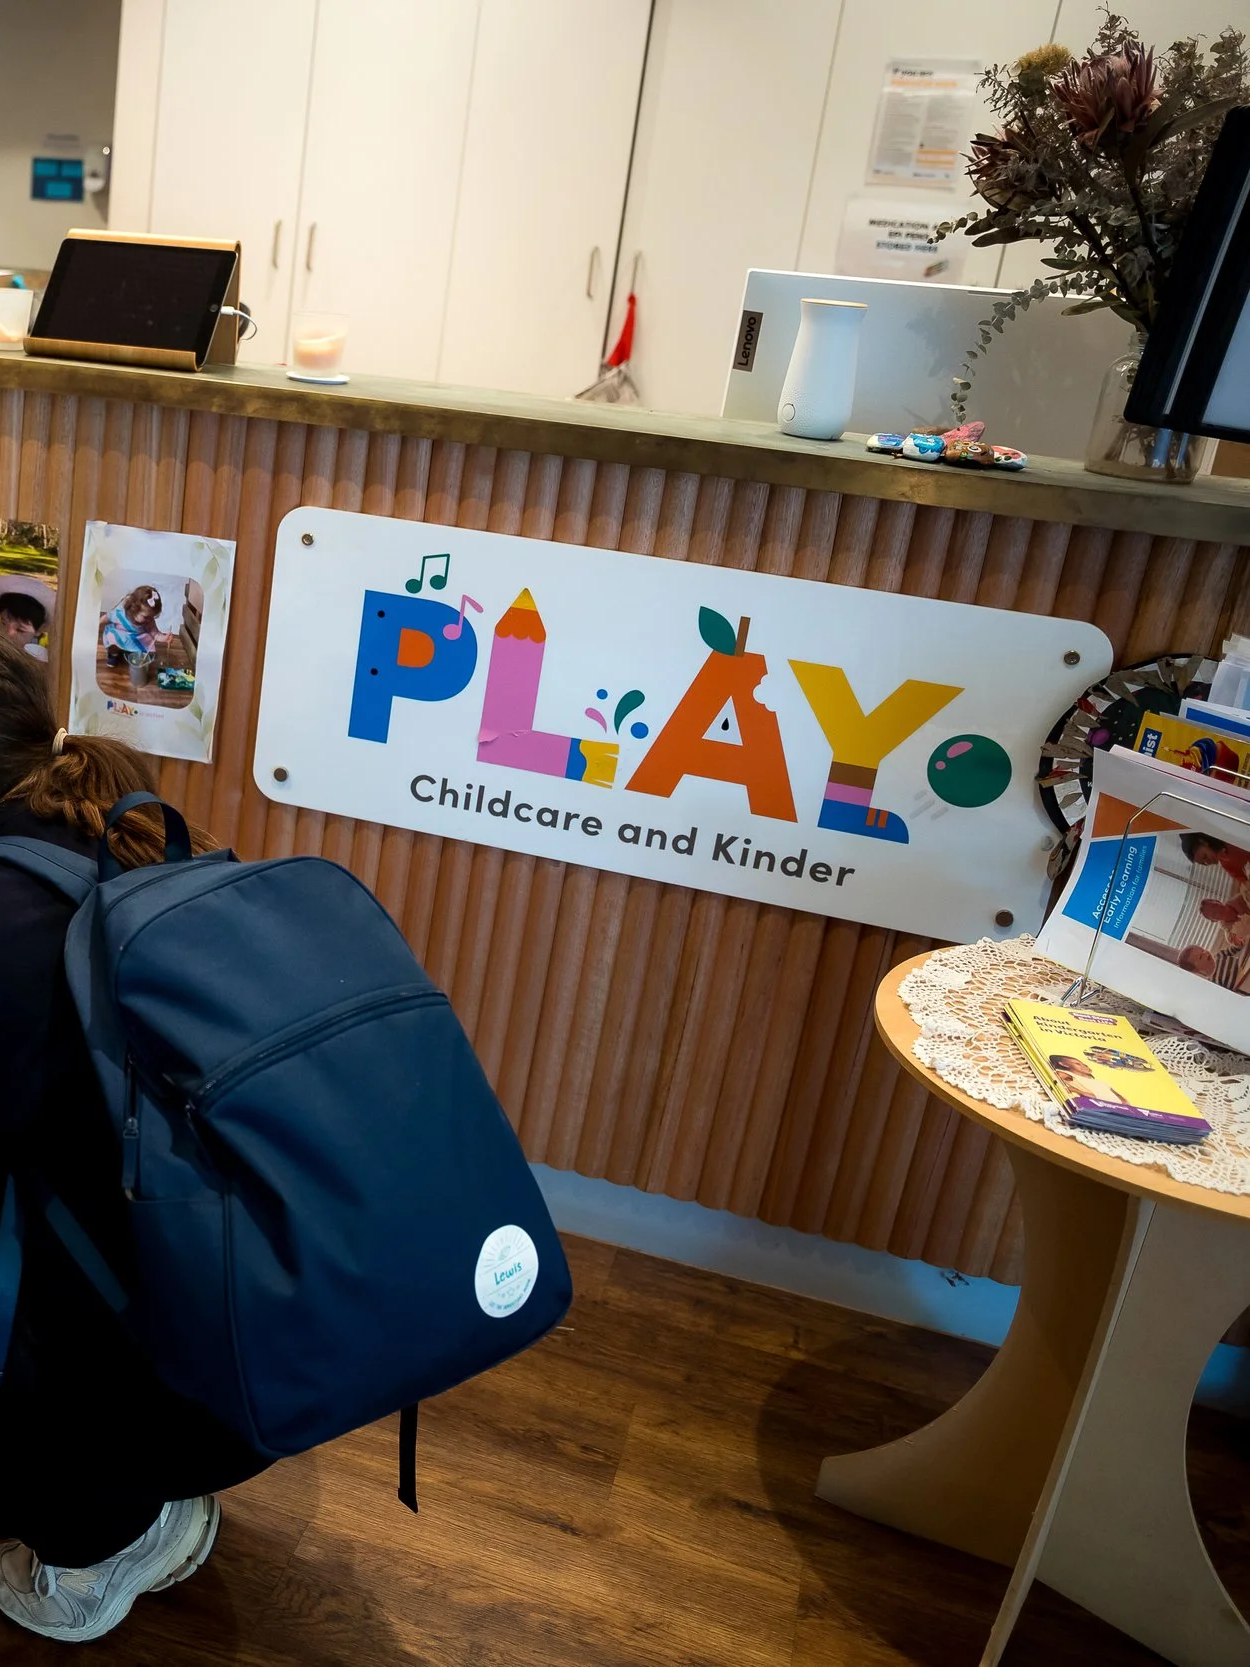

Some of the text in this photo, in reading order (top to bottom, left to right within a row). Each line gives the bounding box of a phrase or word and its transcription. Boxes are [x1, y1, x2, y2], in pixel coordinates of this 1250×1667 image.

[737, 316, 757, 366] Lenovo
[107, 701, 134, 716] PLAY
[348, 588, 965, 844] PLAY
[410, 774, 856, 887] Childcare and Kinder
[1104, 846, 1138, 924] Early Learning
[1114, 845, 1148, 929] Information for families
[1033, 1015, 1071, 1026] About
[1036, 1021, 1123, 1040] kindergarten
[1055, 1029, 1107, 1042] Victoria
[493, 1262, 523, 1286] Lewis
